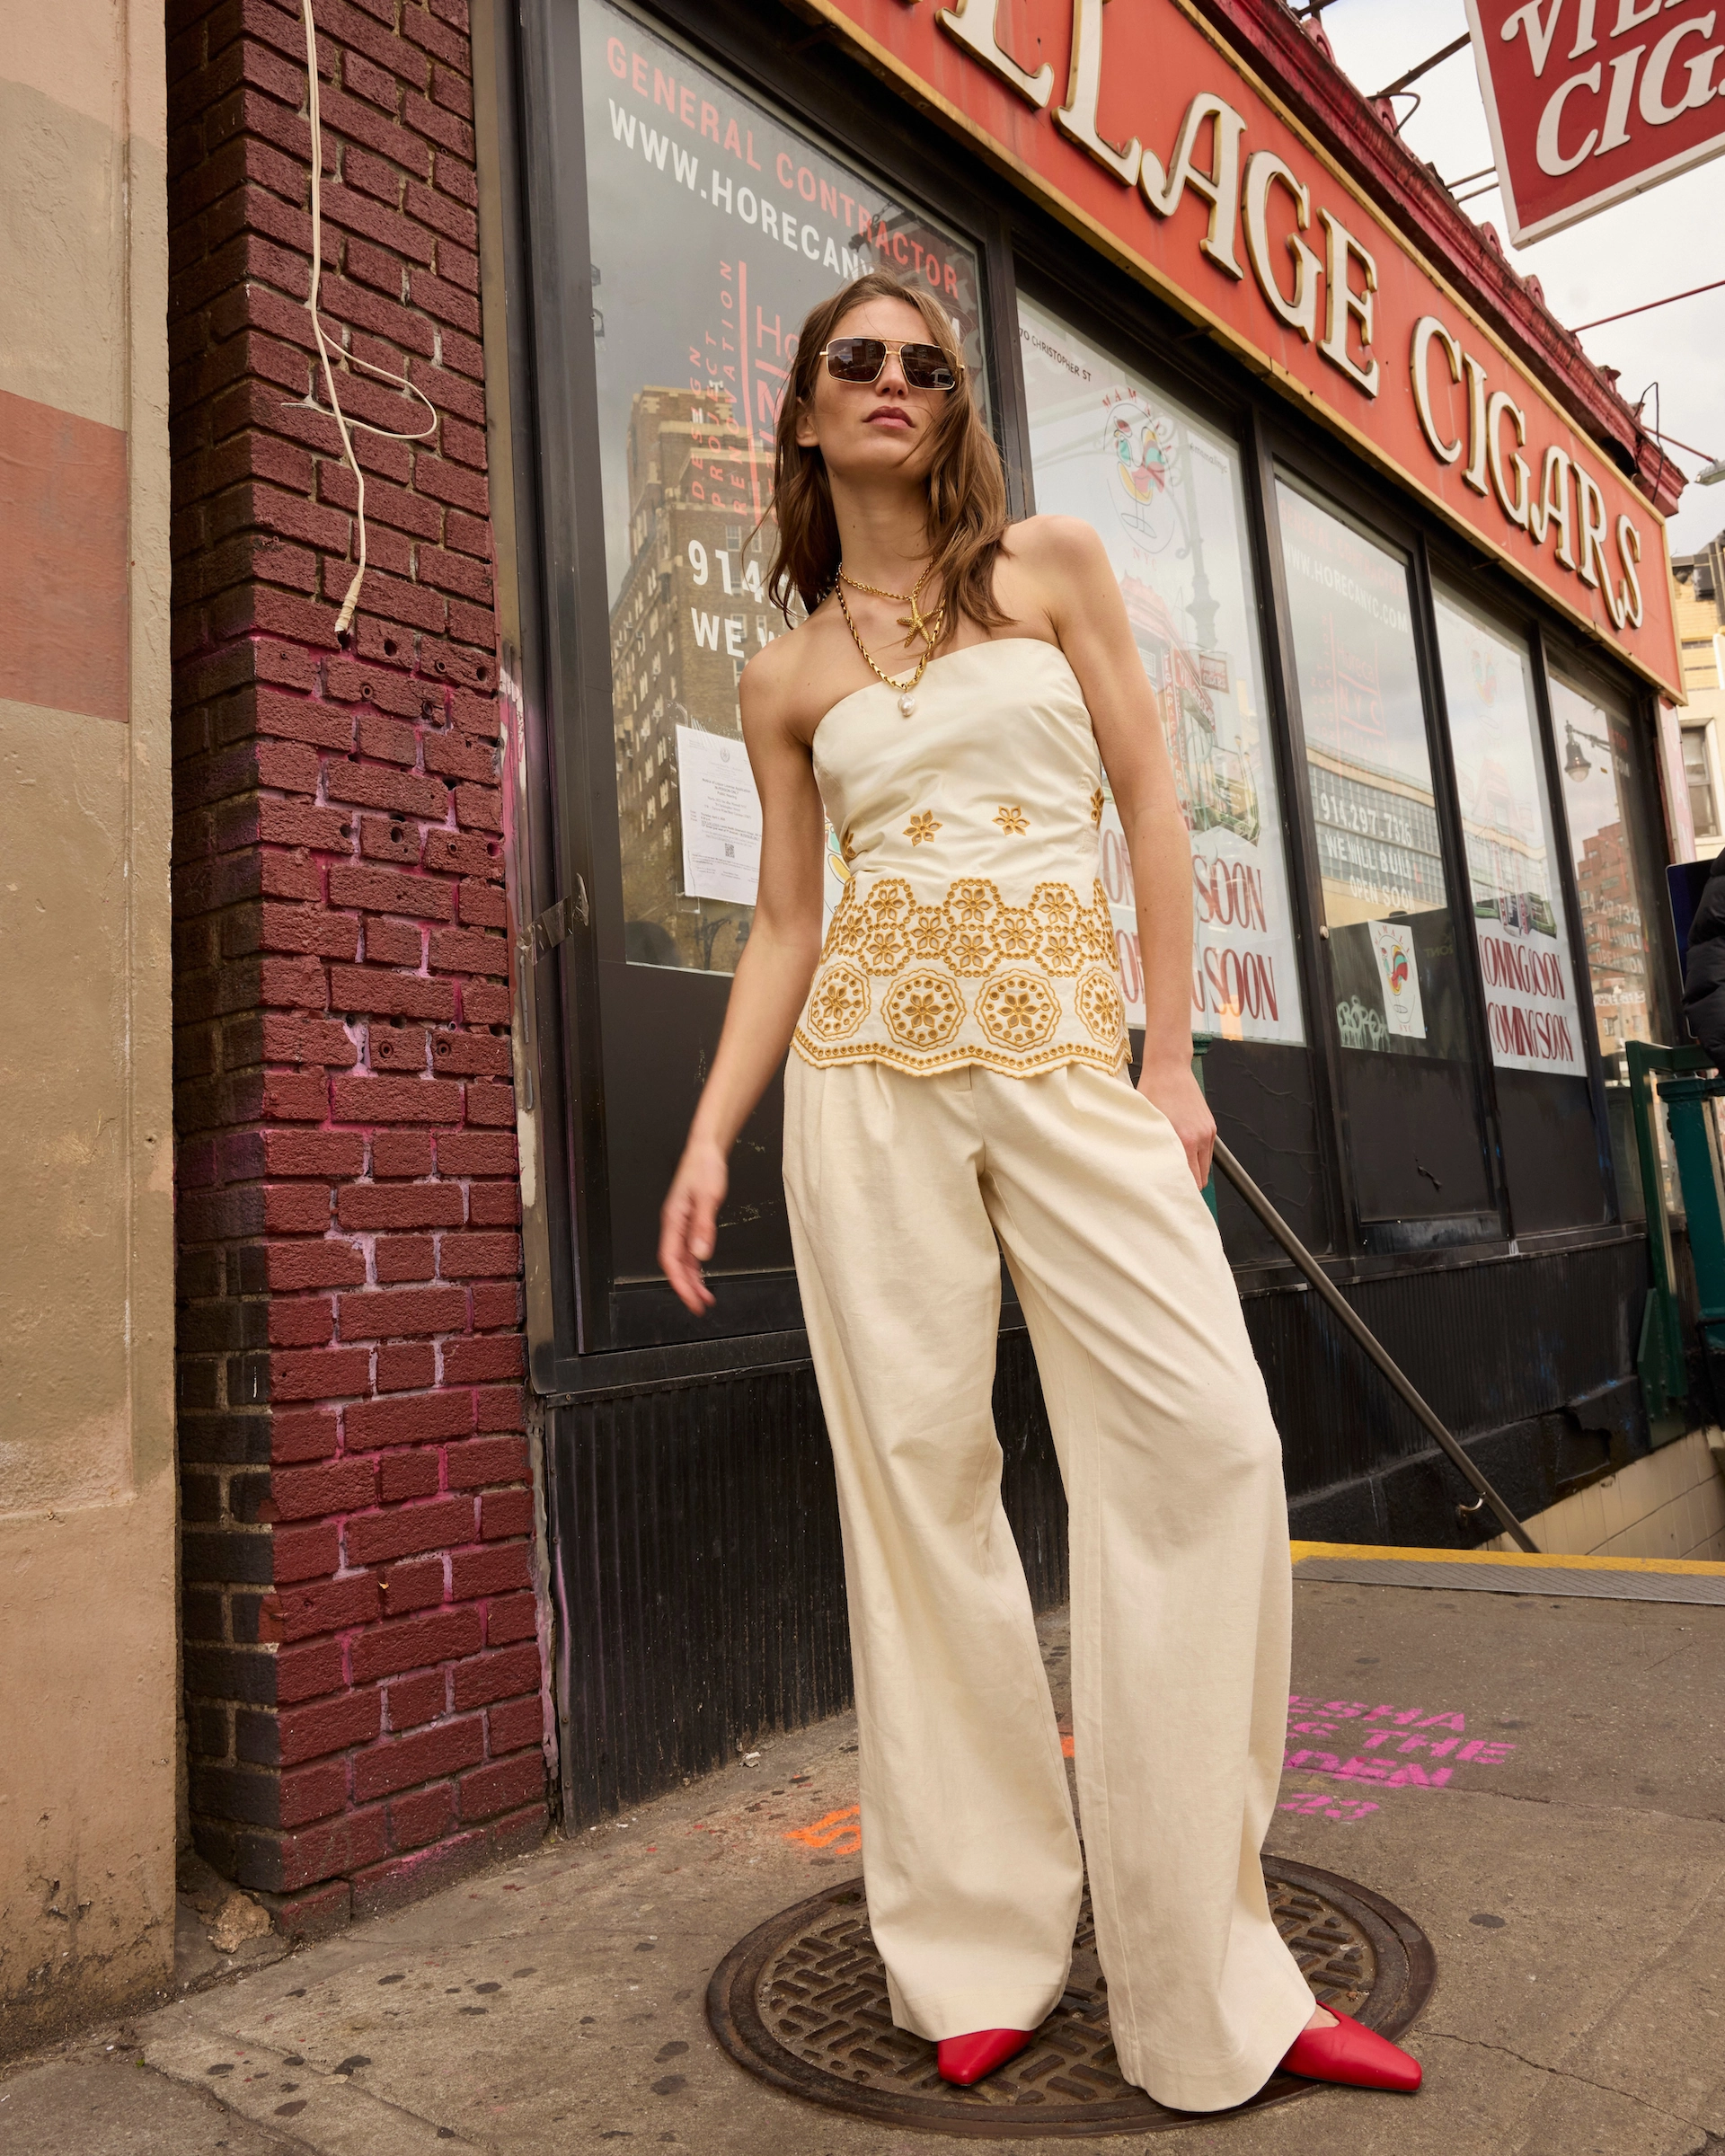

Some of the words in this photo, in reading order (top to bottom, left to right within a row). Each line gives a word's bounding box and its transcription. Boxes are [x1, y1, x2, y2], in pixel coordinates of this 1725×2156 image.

[1536, 10, 1725, 177] CIG
[606, 37, 761, 171] GENERAL
[776, 153, 959, 299] CONTRACTOR
[1031, 335, 1080, 376] CHRISTOPHER
[1082, 369, 1092, 382] ST
[720, 261, 748, 517] RENOVATION
[689, 347, 704, 500] DESIGN
[706, 331, 726, 508] PROJECT
[1411, 315, 1643, 630] CIGARS
[1133, 546, 1157, 570] NYC
[1284, 540, 1409, 633] WWW.HORECANYC.COM
[691, 607, 745, 658] WE
[1340, 682, 1381, 727] NYC
[1320, 792, 1412, 848] 914.297.7326
[1325, 834, 1348, 862] WE
[1348, 841, 1377, 870] WILL
[1379, 850, 1412, 879] BUILD
[1192, 854, 1268, 933] SOON
[1349, 875, 1379, 906] OPEN
[1381, 885, 1416, 911] SOON
[1375, 924, 1411, 953] MAMALI
[1204, 946, 1278, 1022] SOON
[1535, 1012, 1574, 1062] SOON
[1362, 1728, 1517, 1765] THE
